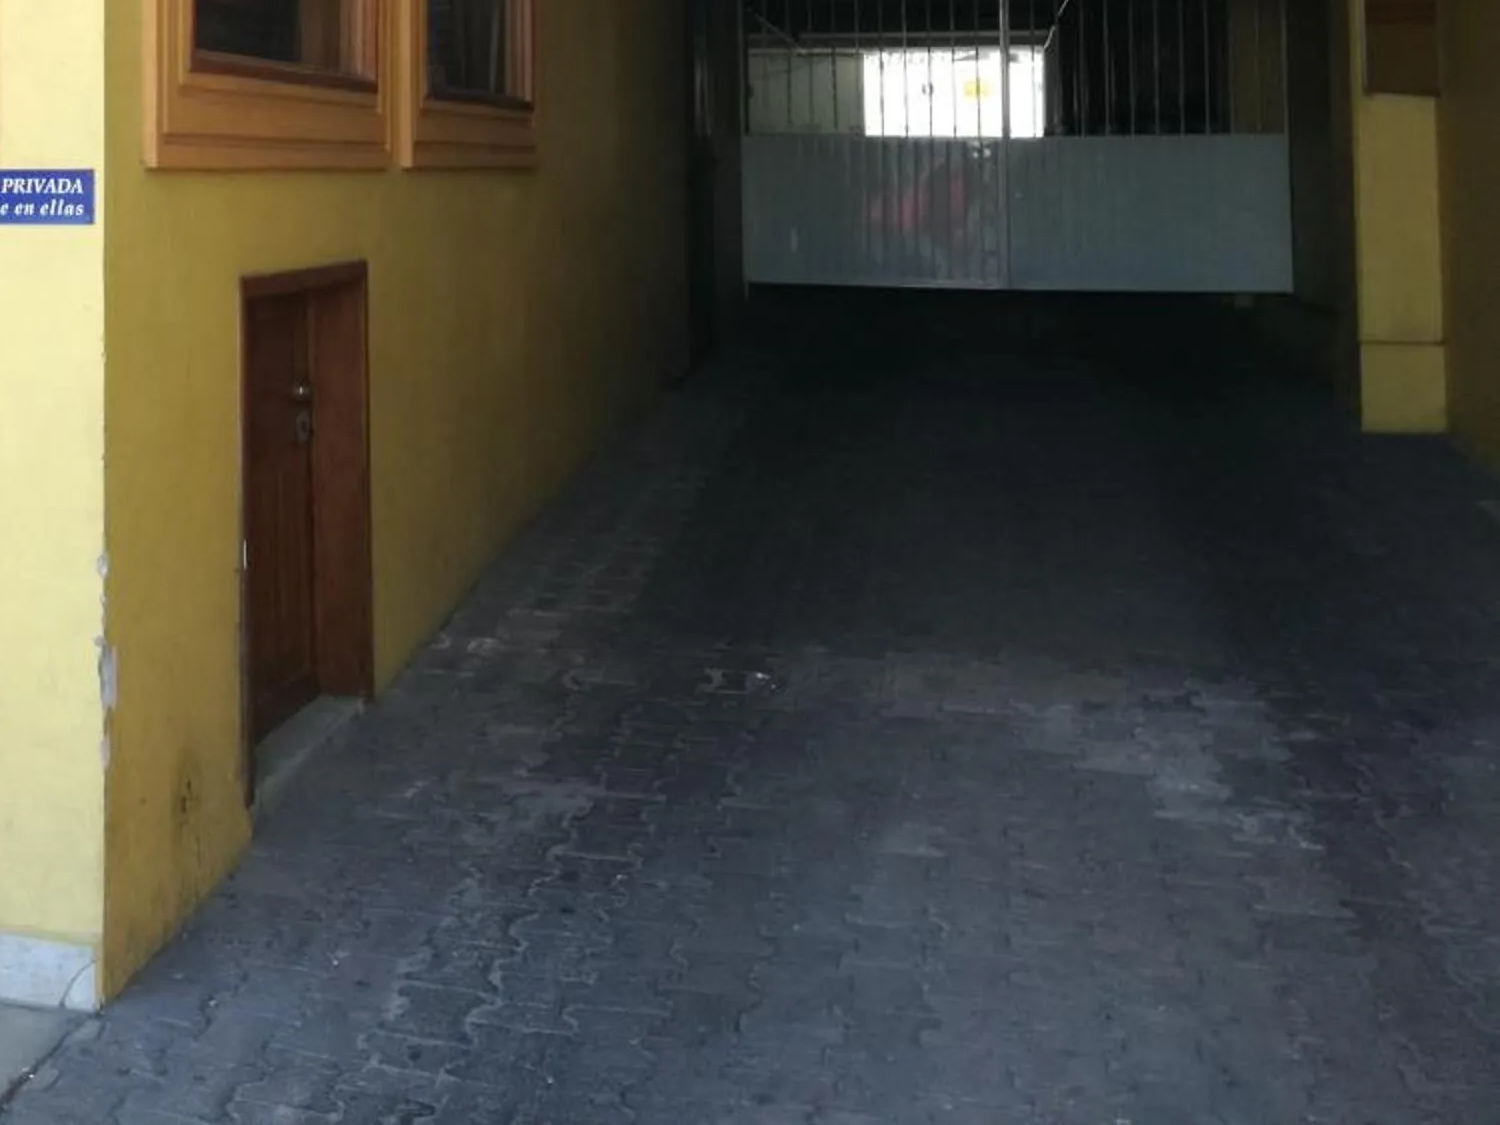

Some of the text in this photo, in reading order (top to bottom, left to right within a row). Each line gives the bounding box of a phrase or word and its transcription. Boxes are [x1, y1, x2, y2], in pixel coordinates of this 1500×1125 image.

[1, 177, 84, 195] PRIVADA
[14, 202, 35, 216] en
[39, 198, 85, 217] ellas
